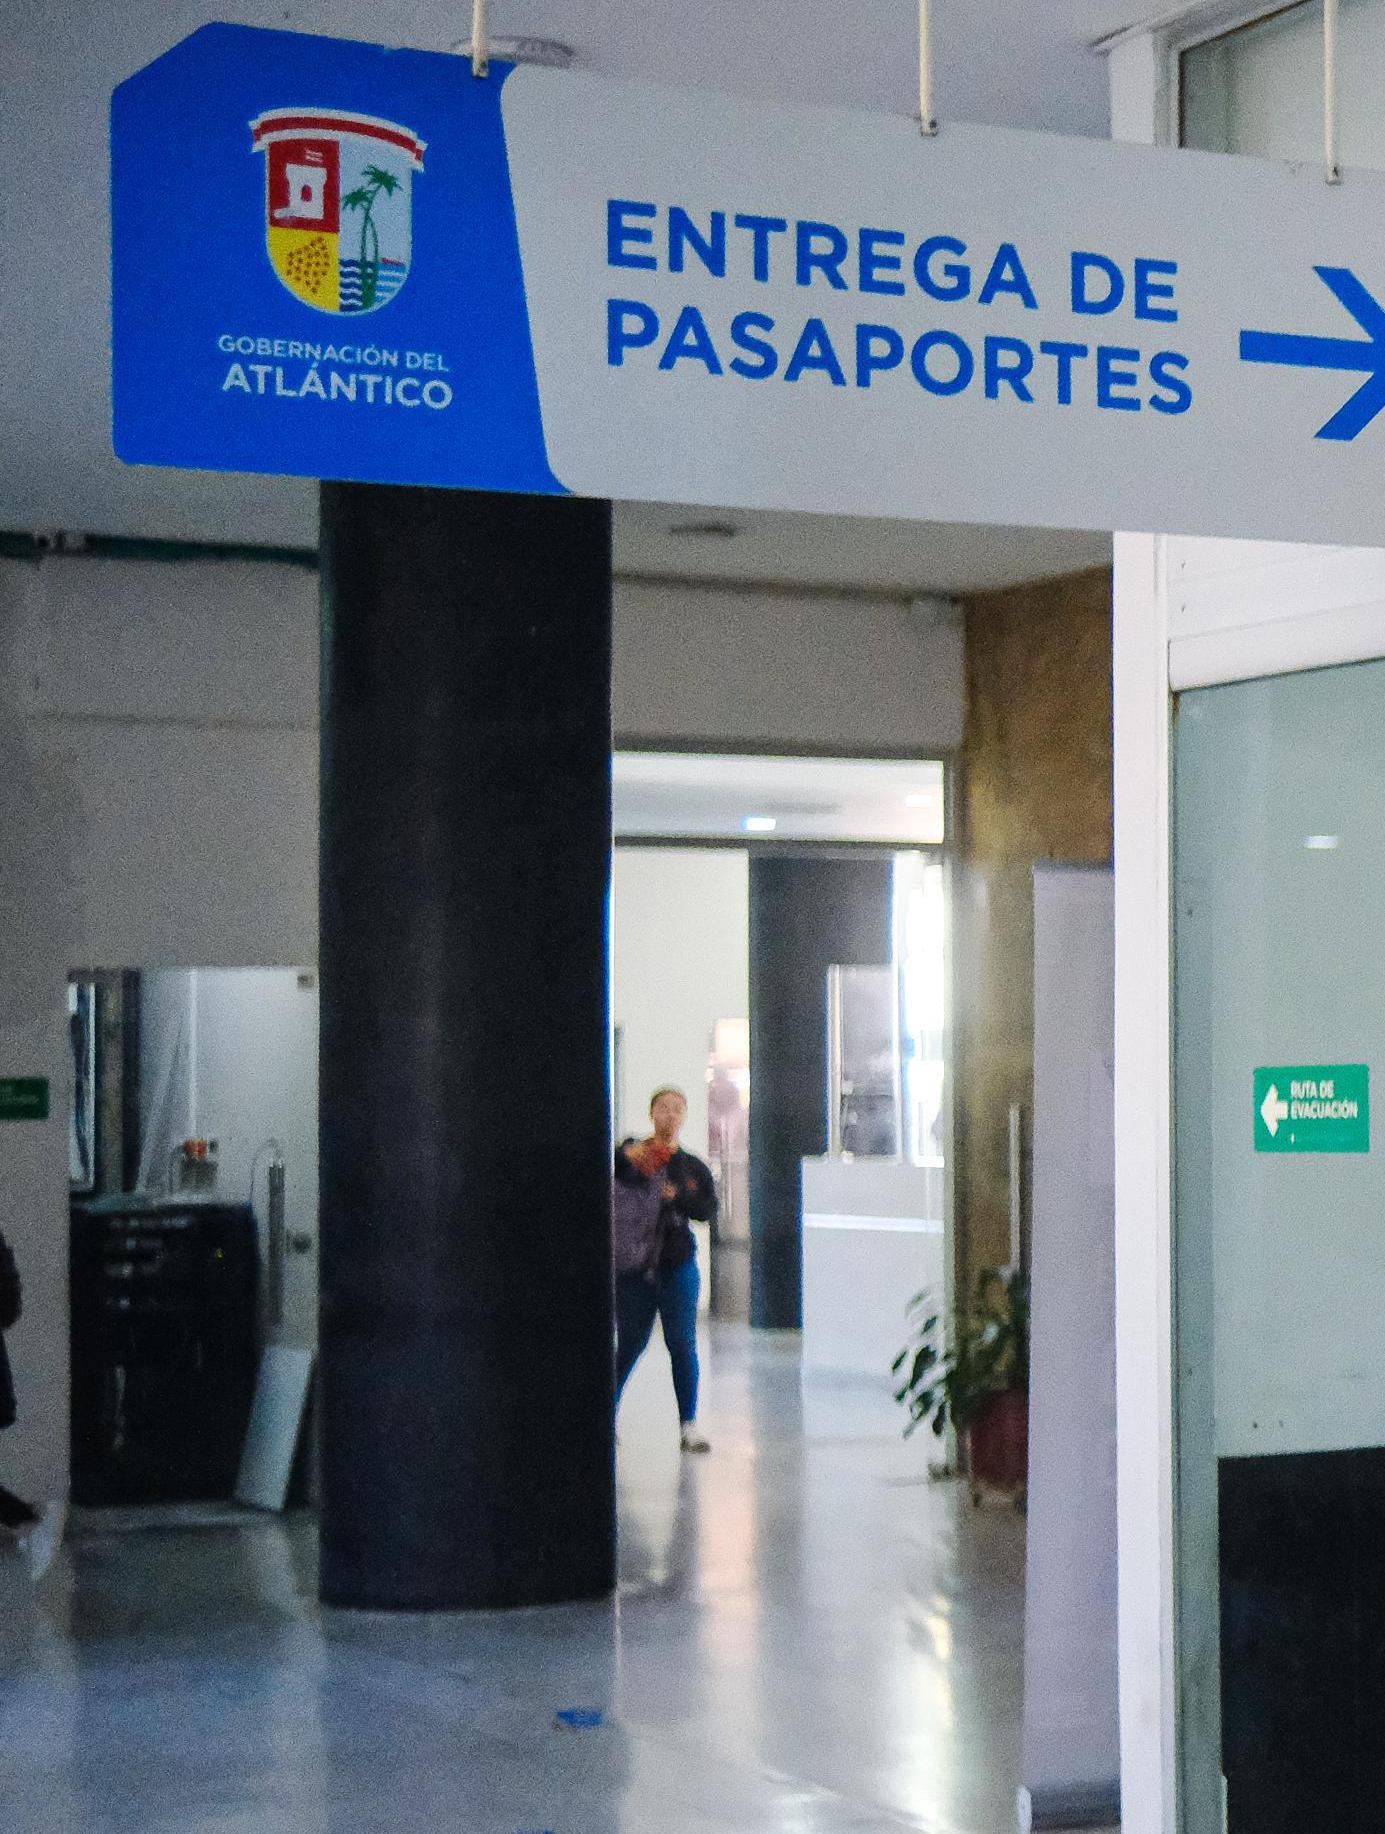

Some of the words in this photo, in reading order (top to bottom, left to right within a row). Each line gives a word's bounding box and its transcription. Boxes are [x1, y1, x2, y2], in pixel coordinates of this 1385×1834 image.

[606, 199, 1037, 308] ENTREGA
[1071, 250, 1179, 322] DE
[218, 334, 399, 367] GOBERNACIÓN
[405, 351, 449, 372] DEL
[606, 298, 1193, 414] PASAPORTES
[222, 362, 453, 409] ATLÁNTICO
[1290, 1079, 1318, 1100] RUTA
[1319, 1079, 1335, 1099] DE
[1290, 1096, 1359, 1120] EVACUACIÓN
